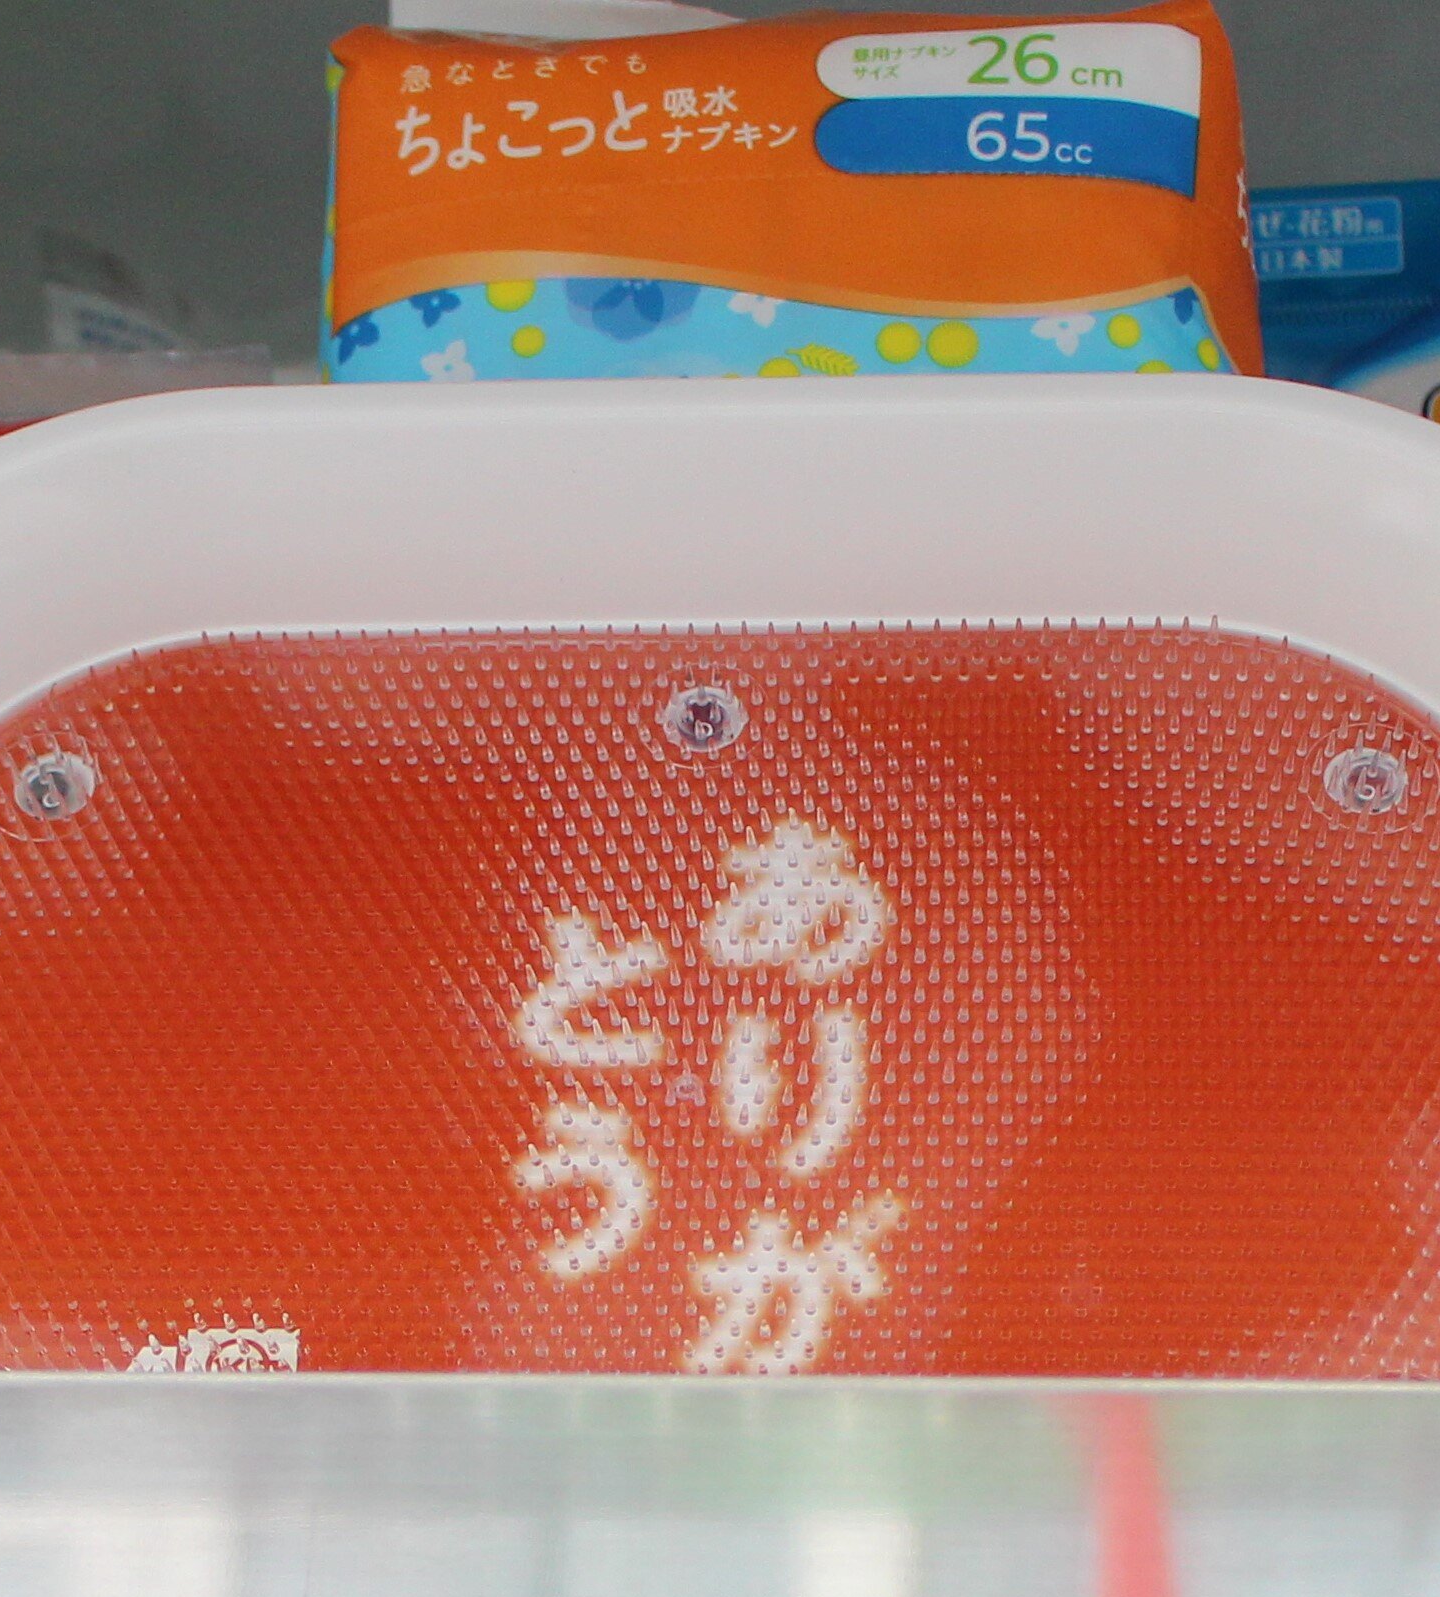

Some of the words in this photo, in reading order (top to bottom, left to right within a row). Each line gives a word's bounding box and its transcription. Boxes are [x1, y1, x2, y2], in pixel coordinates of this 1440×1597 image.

[399, 52, 648, 94] 急なときでも
[966, 33, 1059, 86] 26
[1070, 65, 1123, 88] cm
[662, 86, 739, 118] 吸水
[394, 89, 649, 176] ちょこっと
[660, 121, 799, 154] ナプキン
[513, 904, 671, 1281] とう
[681, 818, 911, 1373] ありが
